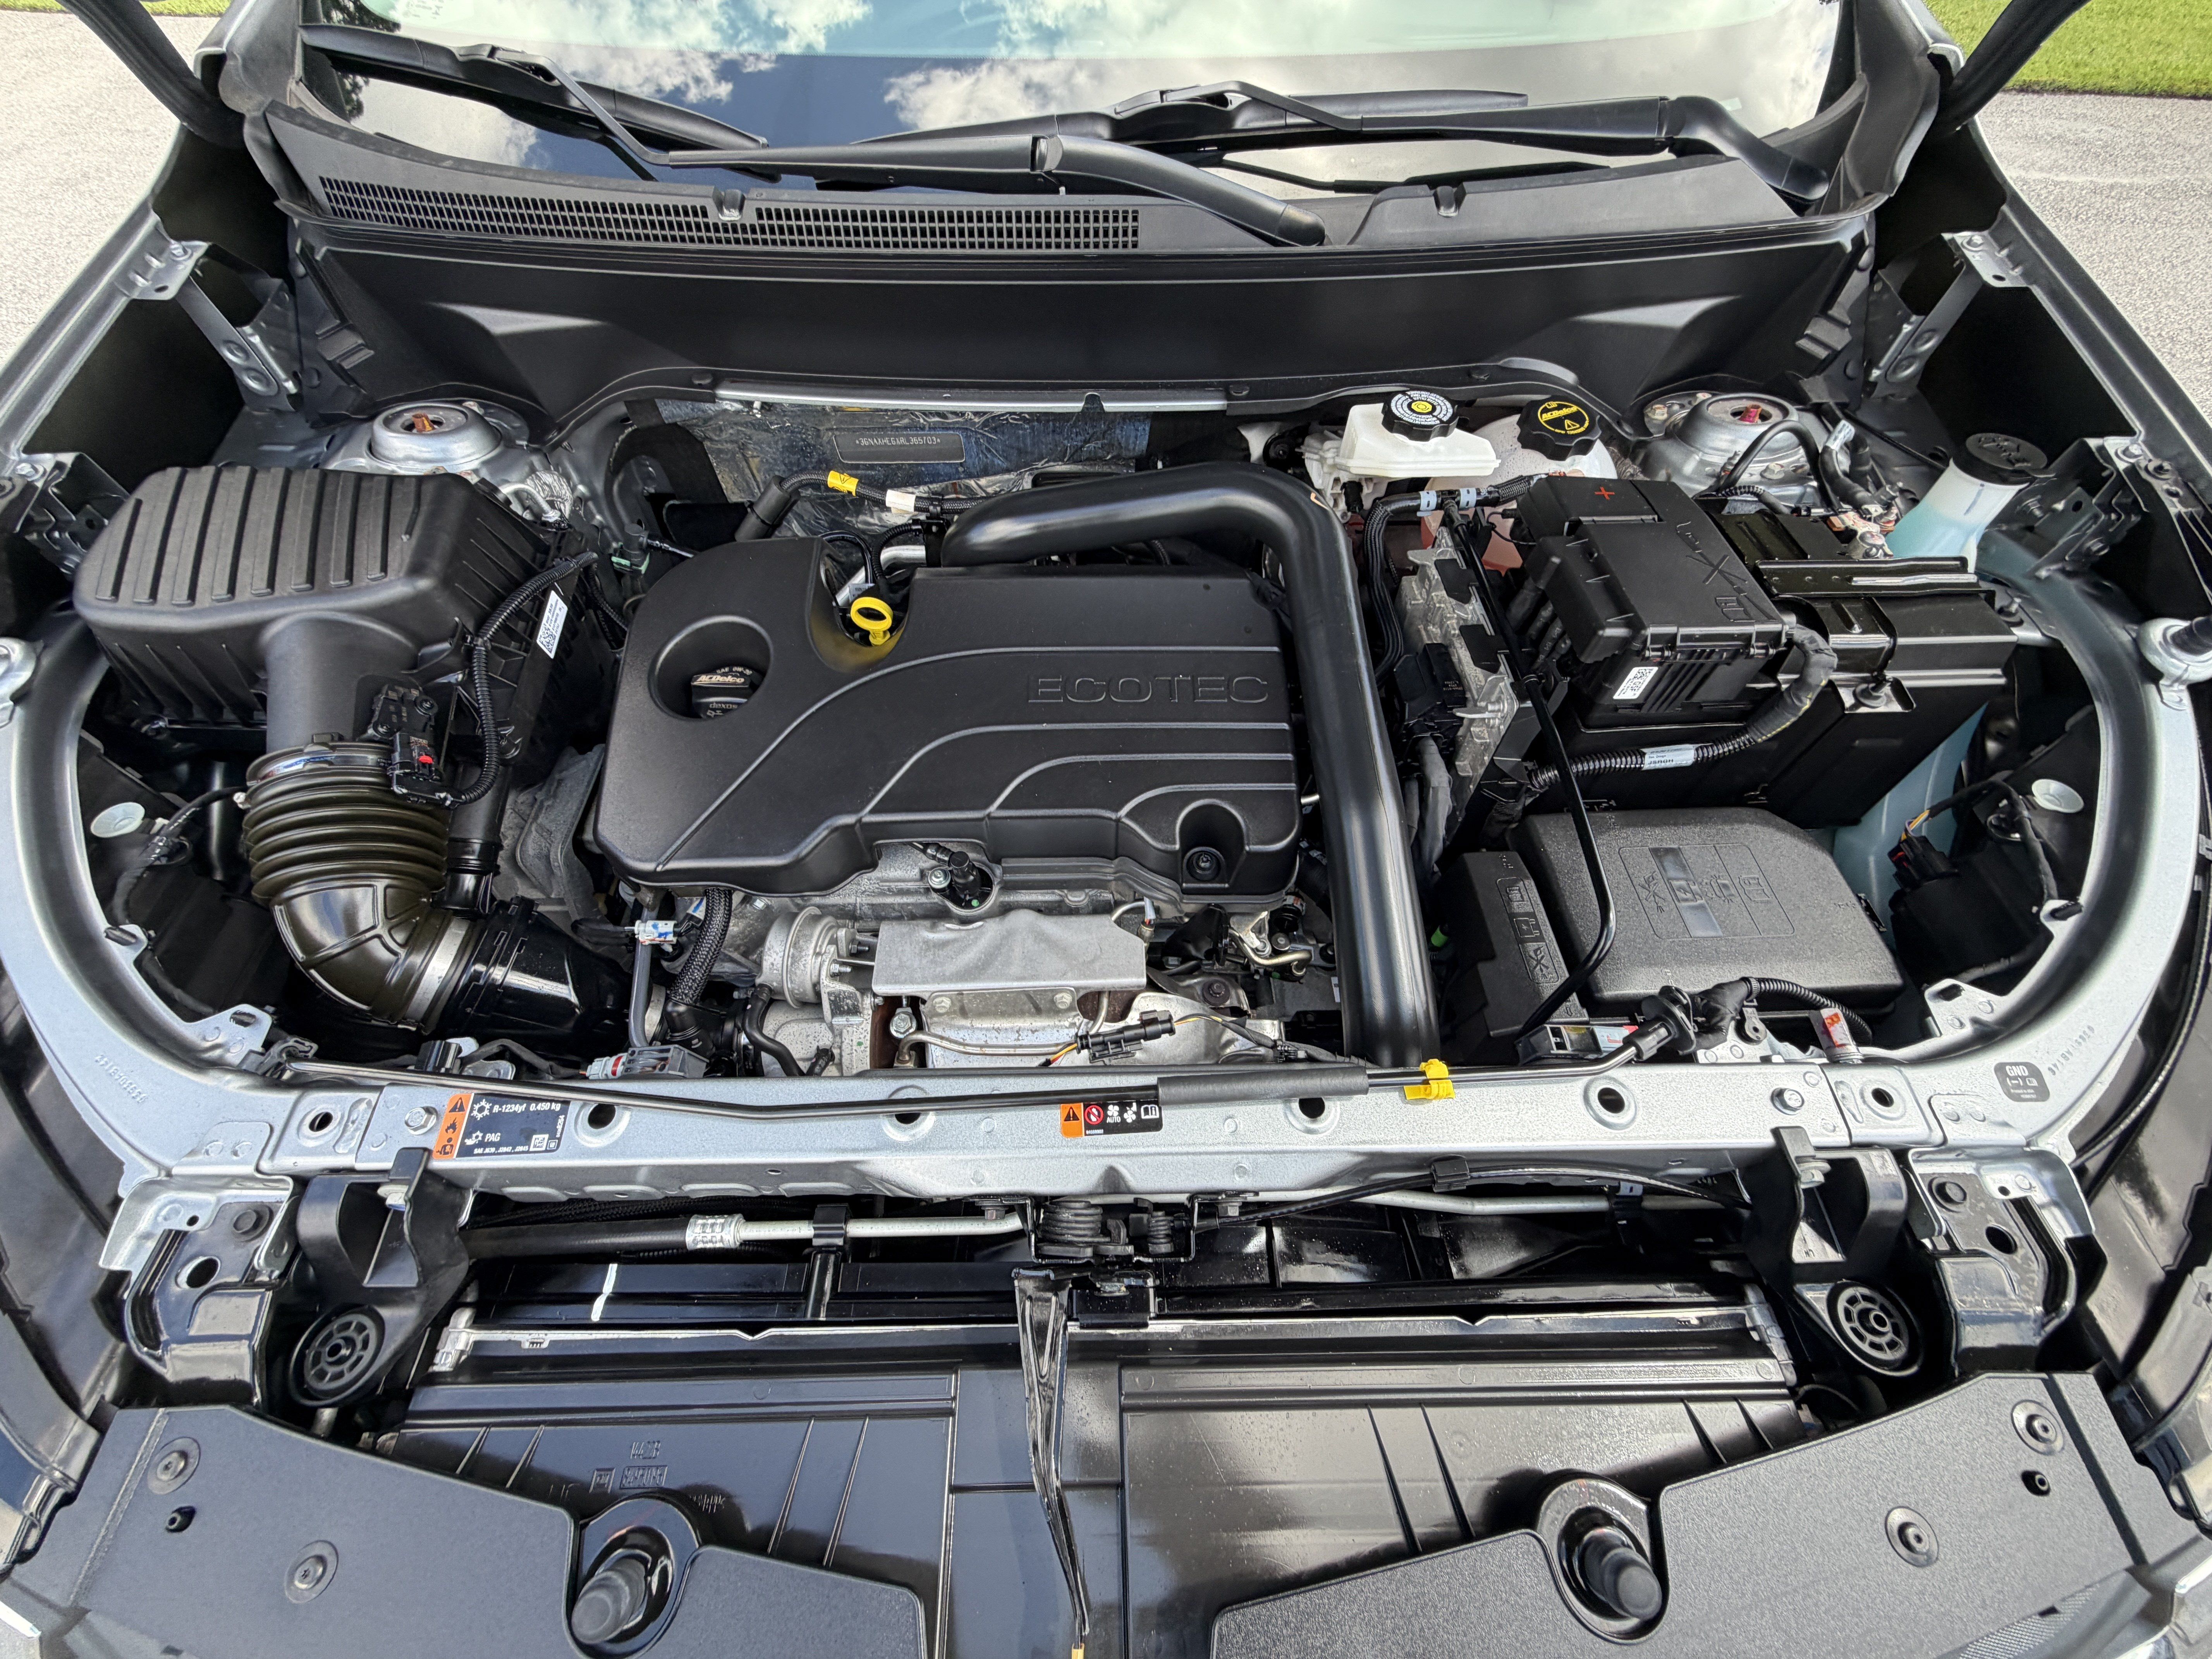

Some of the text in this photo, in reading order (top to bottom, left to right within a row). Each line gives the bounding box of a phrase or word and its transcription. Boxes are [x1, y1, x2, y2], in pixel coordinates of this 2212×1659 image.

[1028, 676, 1268, 703] ECOTEC
[2006, 1065, 2029, 1076] GND
[492, 1102, 560, 1113] R-1234yf 0.450 kg
[485, 1133, 501, 1142] PAG
